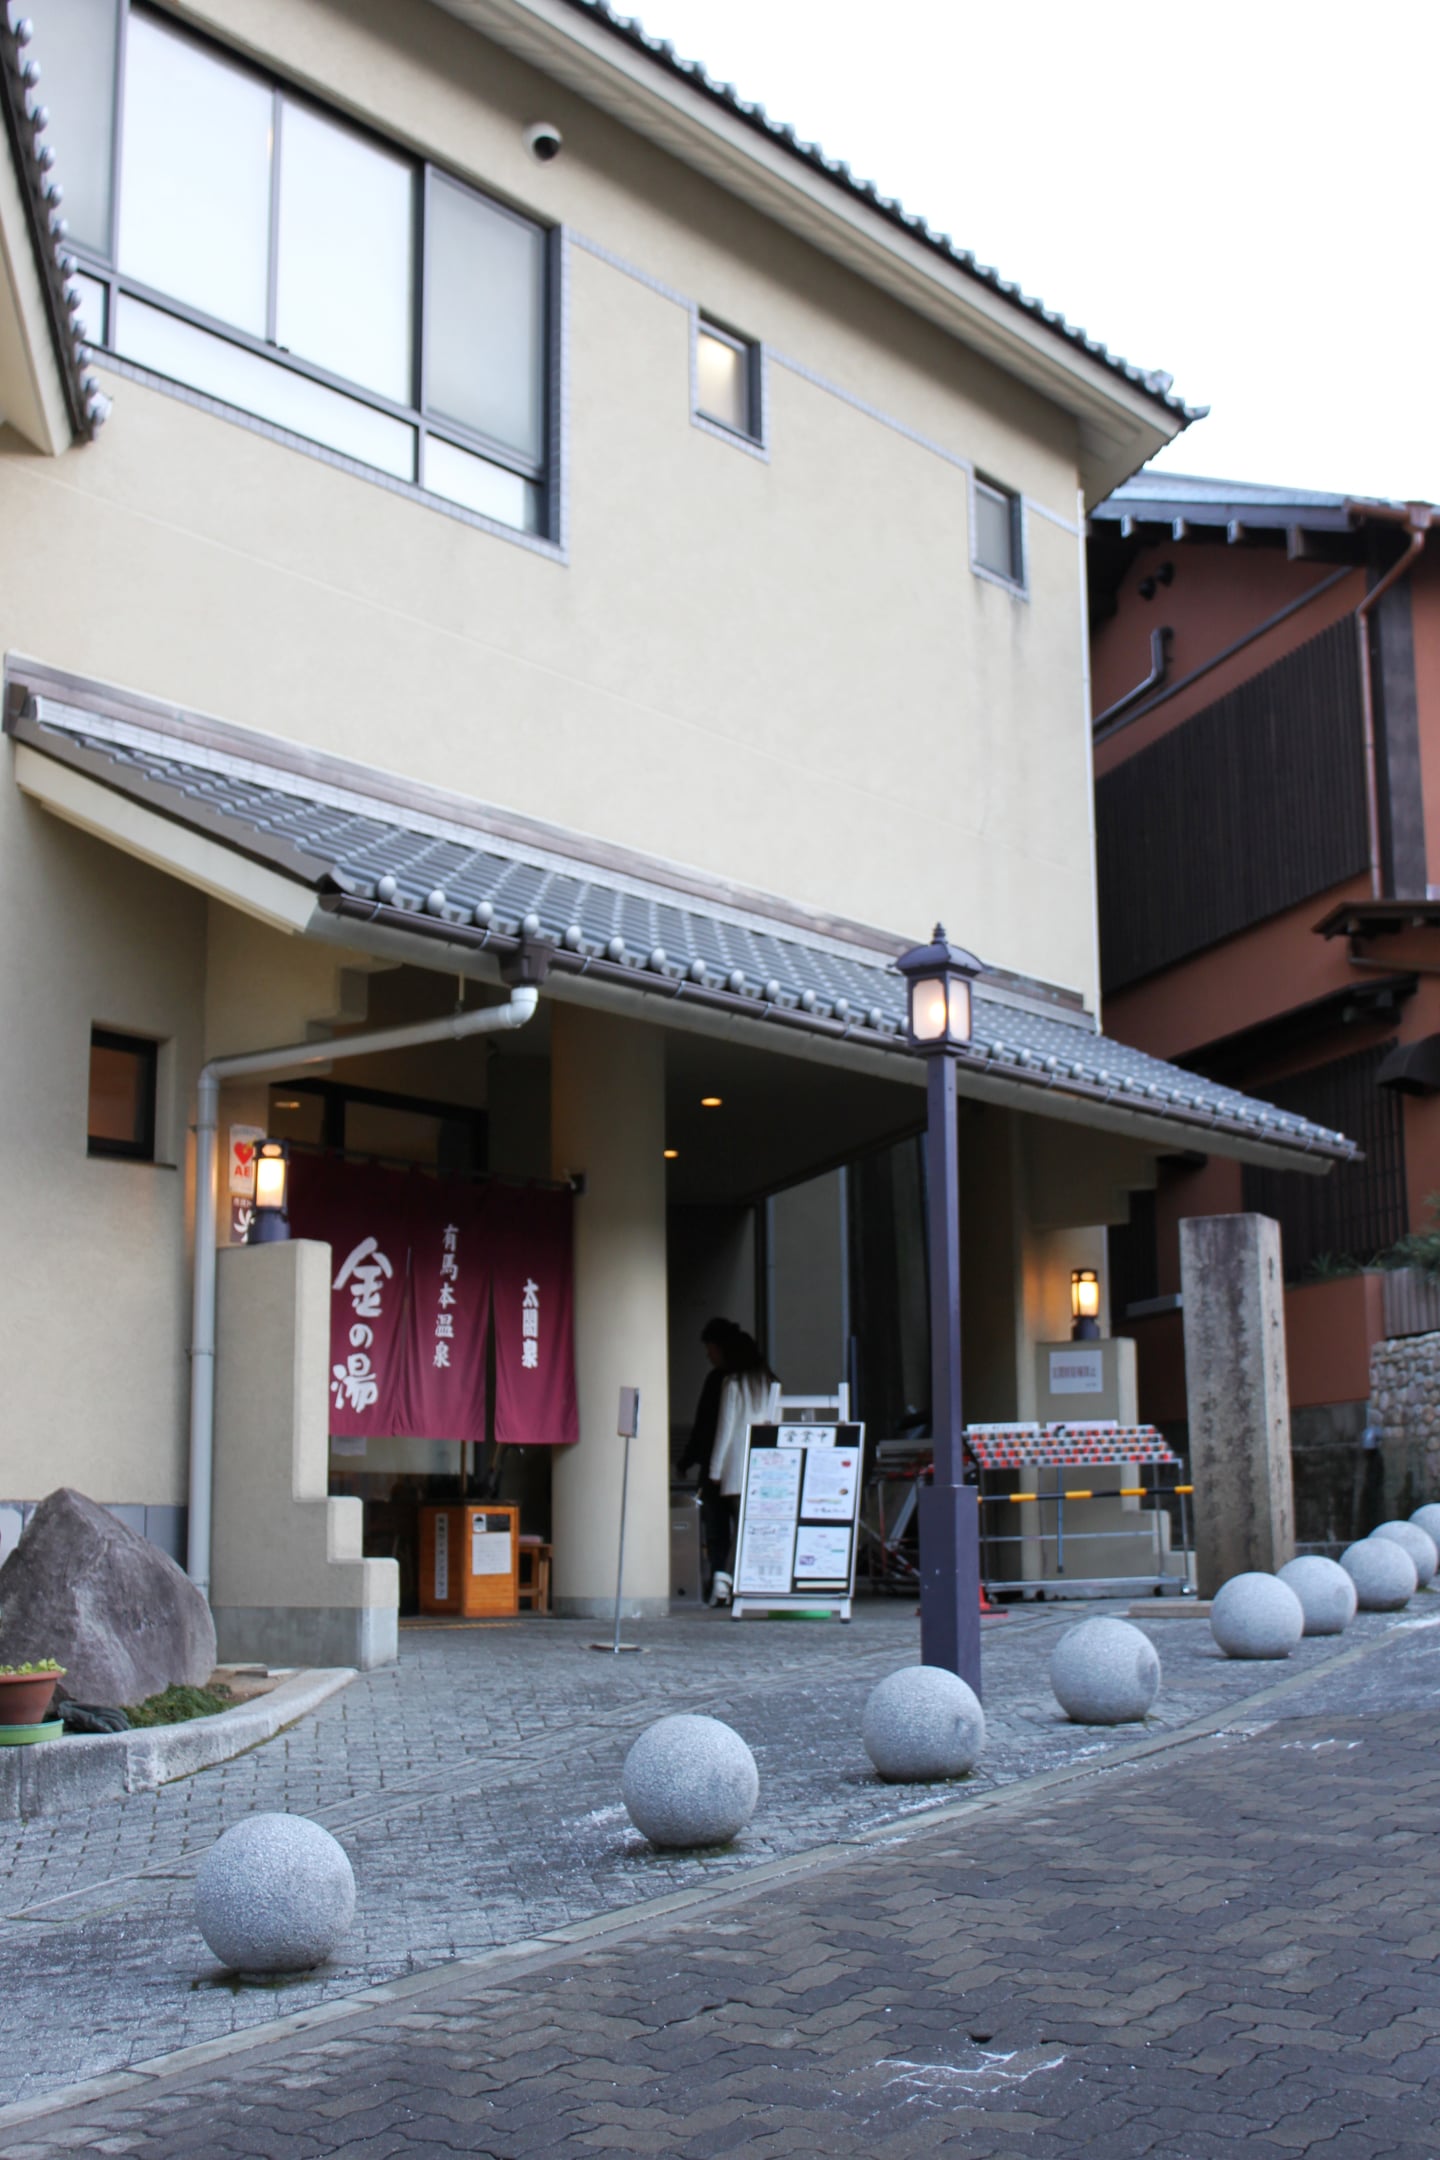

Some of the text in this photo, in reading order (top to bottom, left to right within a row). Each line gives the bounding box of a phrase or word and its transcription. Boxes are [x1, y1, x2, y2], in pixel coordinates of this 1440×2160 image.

[234, 1164, 253, 1178] AE
[330, 1236, 393, 1413] 金の湯
[433, 1223, 459, 1368] 有馬本温泉
